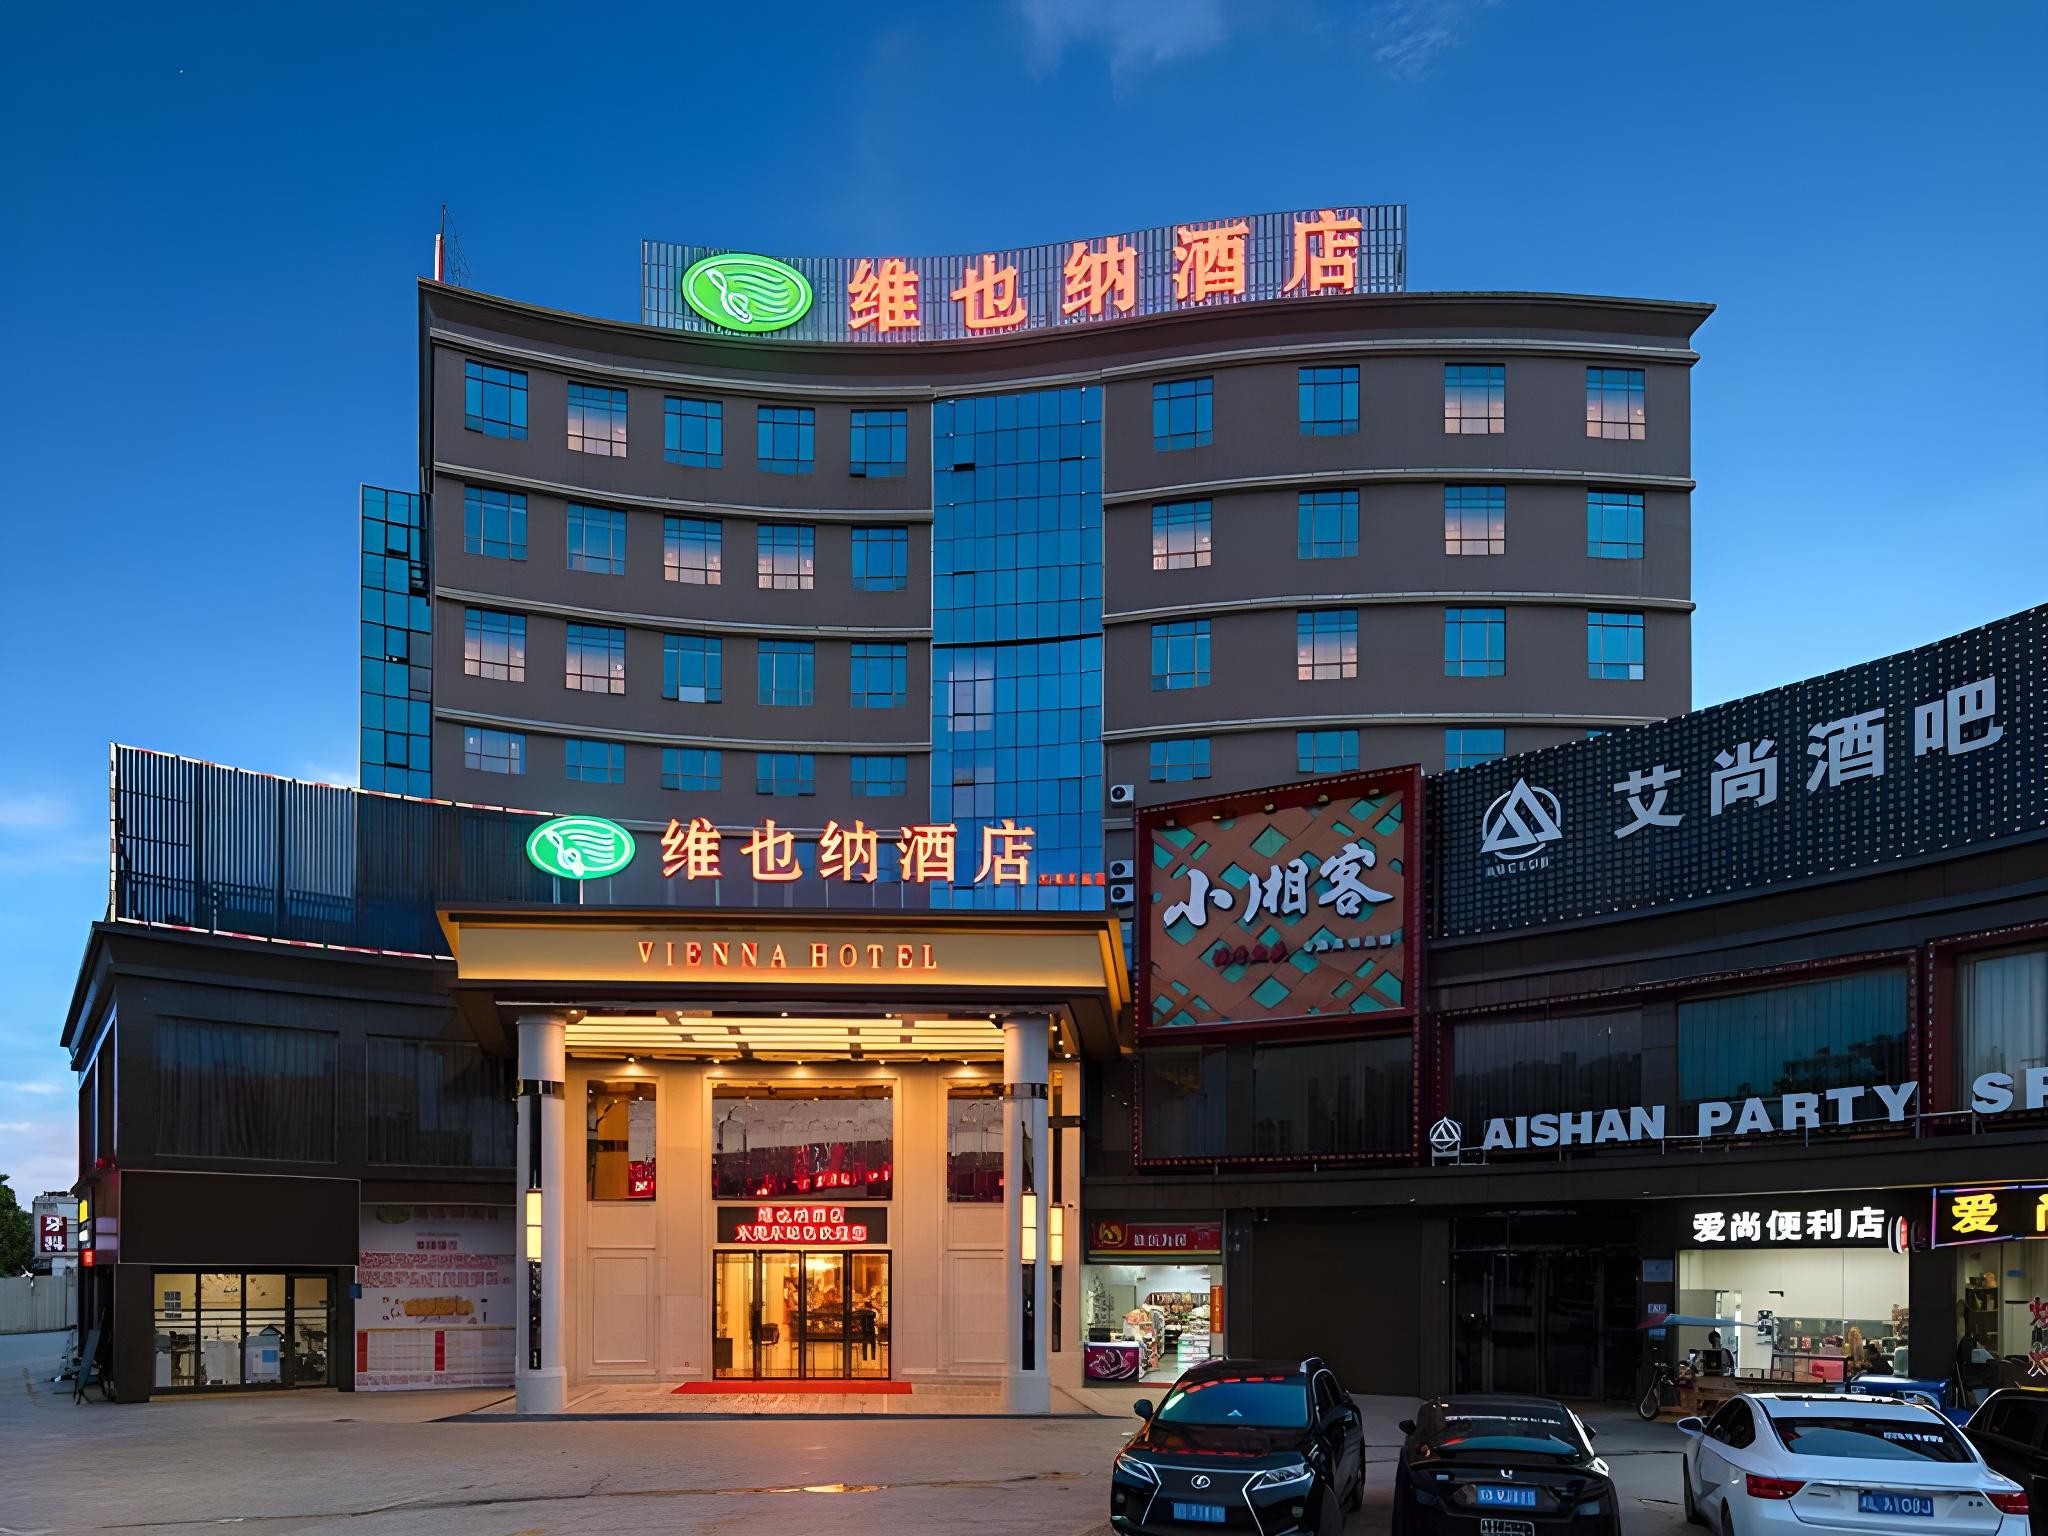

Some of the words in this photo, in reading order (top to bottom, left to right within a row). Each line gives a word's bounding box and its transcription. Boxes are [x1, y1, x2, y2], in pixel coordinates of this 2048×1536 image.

[848, 210, 1362, 333] 维也纳酒店
[1614, 675, 2004, 839] 艾尚酒吧
[659, 817, 1036, 886] 维也纳酒店
[1163, 842, 1395, 927] 小湘客
[637, 941, 788, 969] VIENNA
[809, 942, 938, 969] HOTEL
[1482, 1105, 1666, 1150] AISHAN
[1698, 1081, 1919, 1138] PARTY
[1692, 1206, 1886, 1243] 爱尚便利店
